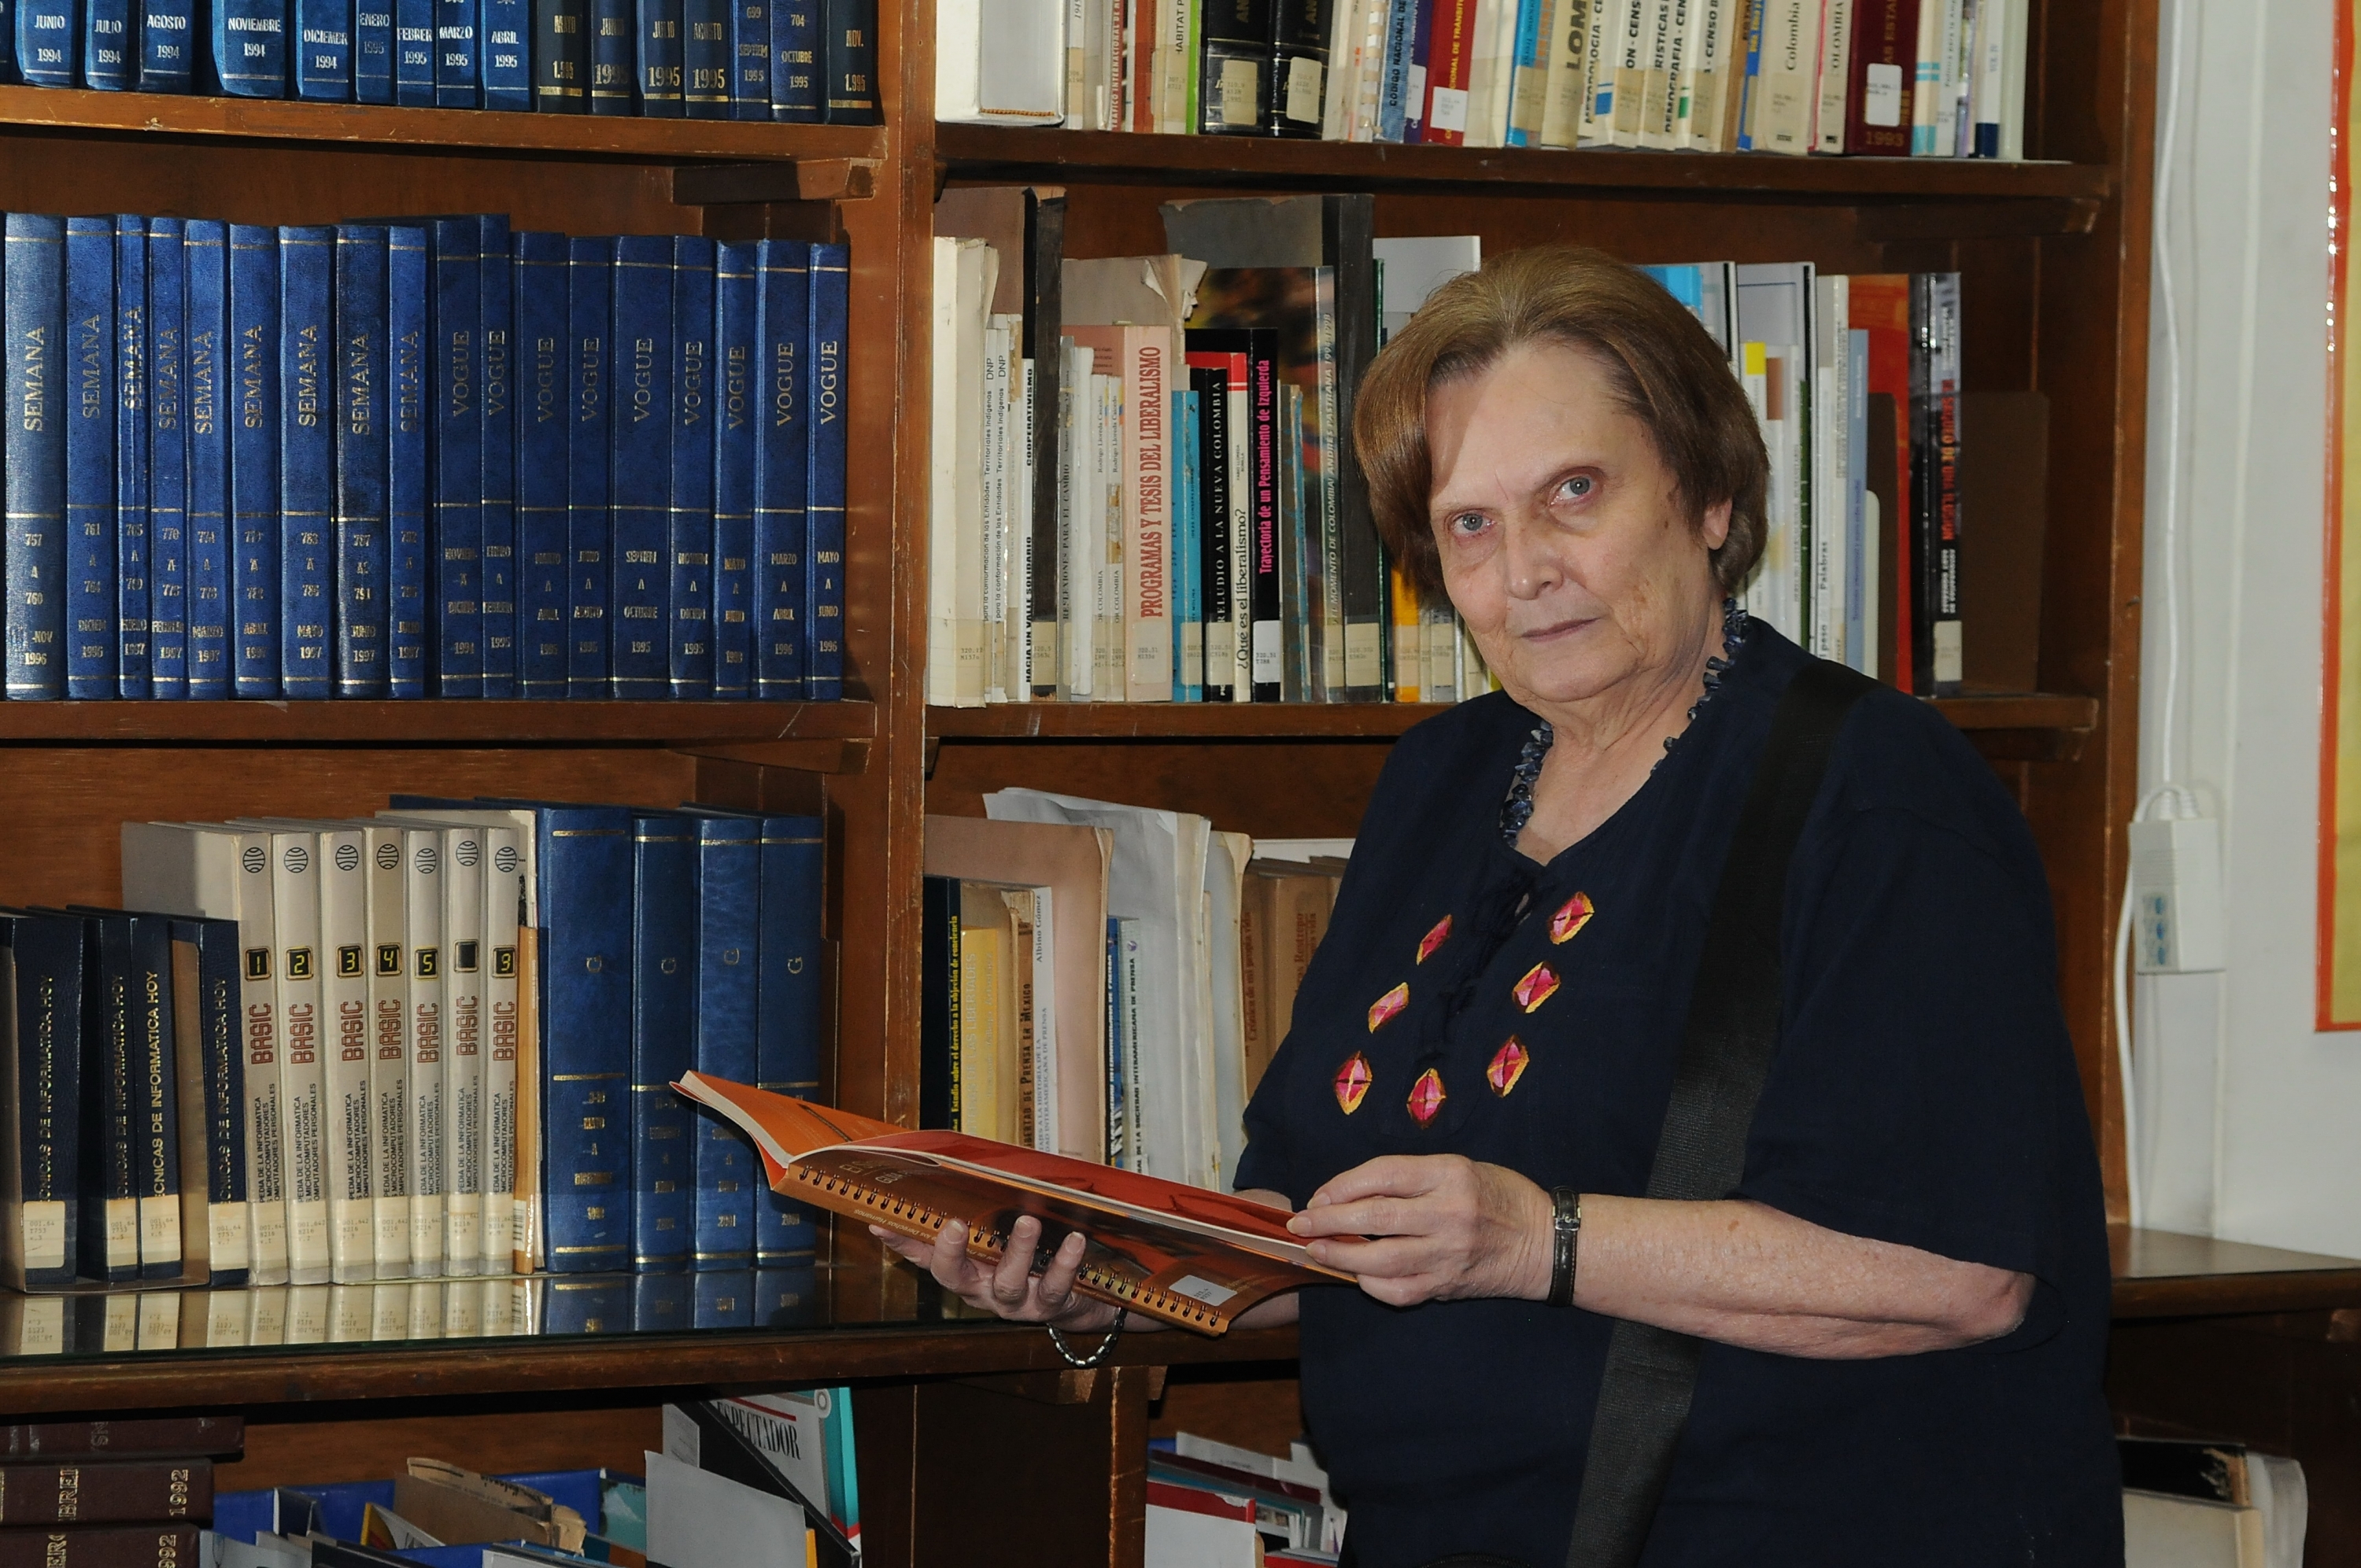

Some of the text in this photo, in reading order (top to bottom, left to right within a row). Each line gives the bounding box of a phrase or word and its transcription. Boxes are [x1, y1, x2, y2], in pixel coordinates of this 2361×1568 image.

[35, 14, 65, 30] JUNIO
[94, 19, 122, 35] JULIO
[146, 14, 187, 30] AGOSTO
[227, 17, 282, 33] NOVIEMBRE
[359, 13, 390, 28] ENERO
[554, 14, 577, 35] MAYO
[304, 29, 348, 46] DICIEMBR
[439, 25, 473, 39] MARZO
[491, 30, 519, 45] ABRIL
[846, 29, 864, 48] NOV.
[1392, 17, 1405, 65] NACIONAL
[1705, 10, 1719, 57] CENSO
[1785, 2, 1801, 71] Colombia
[37, 48, 61, 63] 1994
[98, 49, 121, 64] 1994
[157, 44, 180, 59] 1994
[243, 42, 266, 57] 1994
[363, 40, 385, 56] 1995
[404, 50, 427, 65] 1995
[781, 50, 813, 65] OCTUBRE
[1111, 24, 1120, 90] INTERNACIONAL
[1452, 42, 1460, 53] DE
[315, 54, 338, 70] 1994
[445, 52, 468, 67] 1995
[494, 53, 518, 68] 1995
[648, 66, 681, 87] 1995
[693, 68, 725, 89] 1995
[744, 69, 764, 83] 1995
[789, 75, 809, 89] 1995
[845, 72, 866, 93] 1.995
[83, 314, 100, 419] SEMANA
[124, 305, 142, 411] SEMANA
[24, 326, 45, 431] SEMANA
[159, 326, 178, 430] SEMANA
[194, 330, 212, 434] SEMANA
[245, 324, 263, 429] SEMANA
[298, 323, 317, 427] SEMANA
[401, 330, 419, 434] SEMANA
[453, 330, 469, 417] VOGUE
[489, 330, 505, 416] VOGUE
[538, 337, 555, 422] VOGUE
[582, 337, 600, 422] VOGUE
[634, 338, 652, 422] VOGUE
[685, 341, 702, 426] VOGUE
[777, 341, 794, 426] VOGUE
[821, 340, 837, 425] VOGUE
[353, 332, 371, 436] SEMANA
[729, 345, 745, 430] VOGUE
[1212, 382, 1223, 459] COLOMBIA
[1256, 360, 1274, 574] Trayectoria de un Pensamiento de Izquierda
[1139, 347, 1162, 618] PROGRAMAS Y TESIS DEL LIBERALISMO
[1212, 465, 1223, 514] NUEVA
[1062, 506, 1069, 518] EL
[24, 533, 42, 547] 757
[84, 523, 100, 536] 761
[1215, 521, 1224, 538] LA
[1328, 536, 1336, 549] DE
[771, 553, 796, 565] MARZO
[818, 552, 840, 563] MAYO
[31, 566, 39, 579] A
[1329, 552, 1339, 603] MOMENTO
[825, 578, 832, 589] A
[1235, 508, 1249, 670] ¿Qué es el liberalismo?
[25, 592, 43, 605] 760
[819, 640, 837, 652] 1996
[1025, 632, 1032, 645] UN
[24, 652, 47, 666] 1996
[353, 650, 375, 662] 1997
[256, 956, 260, 972] 1
[294, 955, 305, 972] 2
[346, 953, 355, 971] 3
[384, 951, 394, 967] 4
[423, 954, 433, 972] 5
[1130, 994, 1137, 1005] DE
[250, 1003, 273, 1064] BASIC
[290, 1003, 314, 1064] BASIC
[342, 1000, 364, 1061] BASIC
[379, 999, 401, 1061] BASIC
[417, 1002, 439, 1062] BASIC
[456, 996, 478, 1056] BASIC
[493, 1001, 515, 1061] BASIC
[146, 971, 163, 1133] DE INFORMATICA HOY
[268, 1083, 277, 1138] PERSONALES
[345, 1094, 353, 1148] INFORMATICA
[254, 1097, 264, 1177] DE LA INFORMATICA
[353, 1099, 362, 1194] MICROCOMPUTADORES
[262, 1102, 272, 1196] MICROCOMPUTADORES
[854, 1209, 919, 1235] Derechos Humanos
[169, 1469, 189, 1517] 1992
